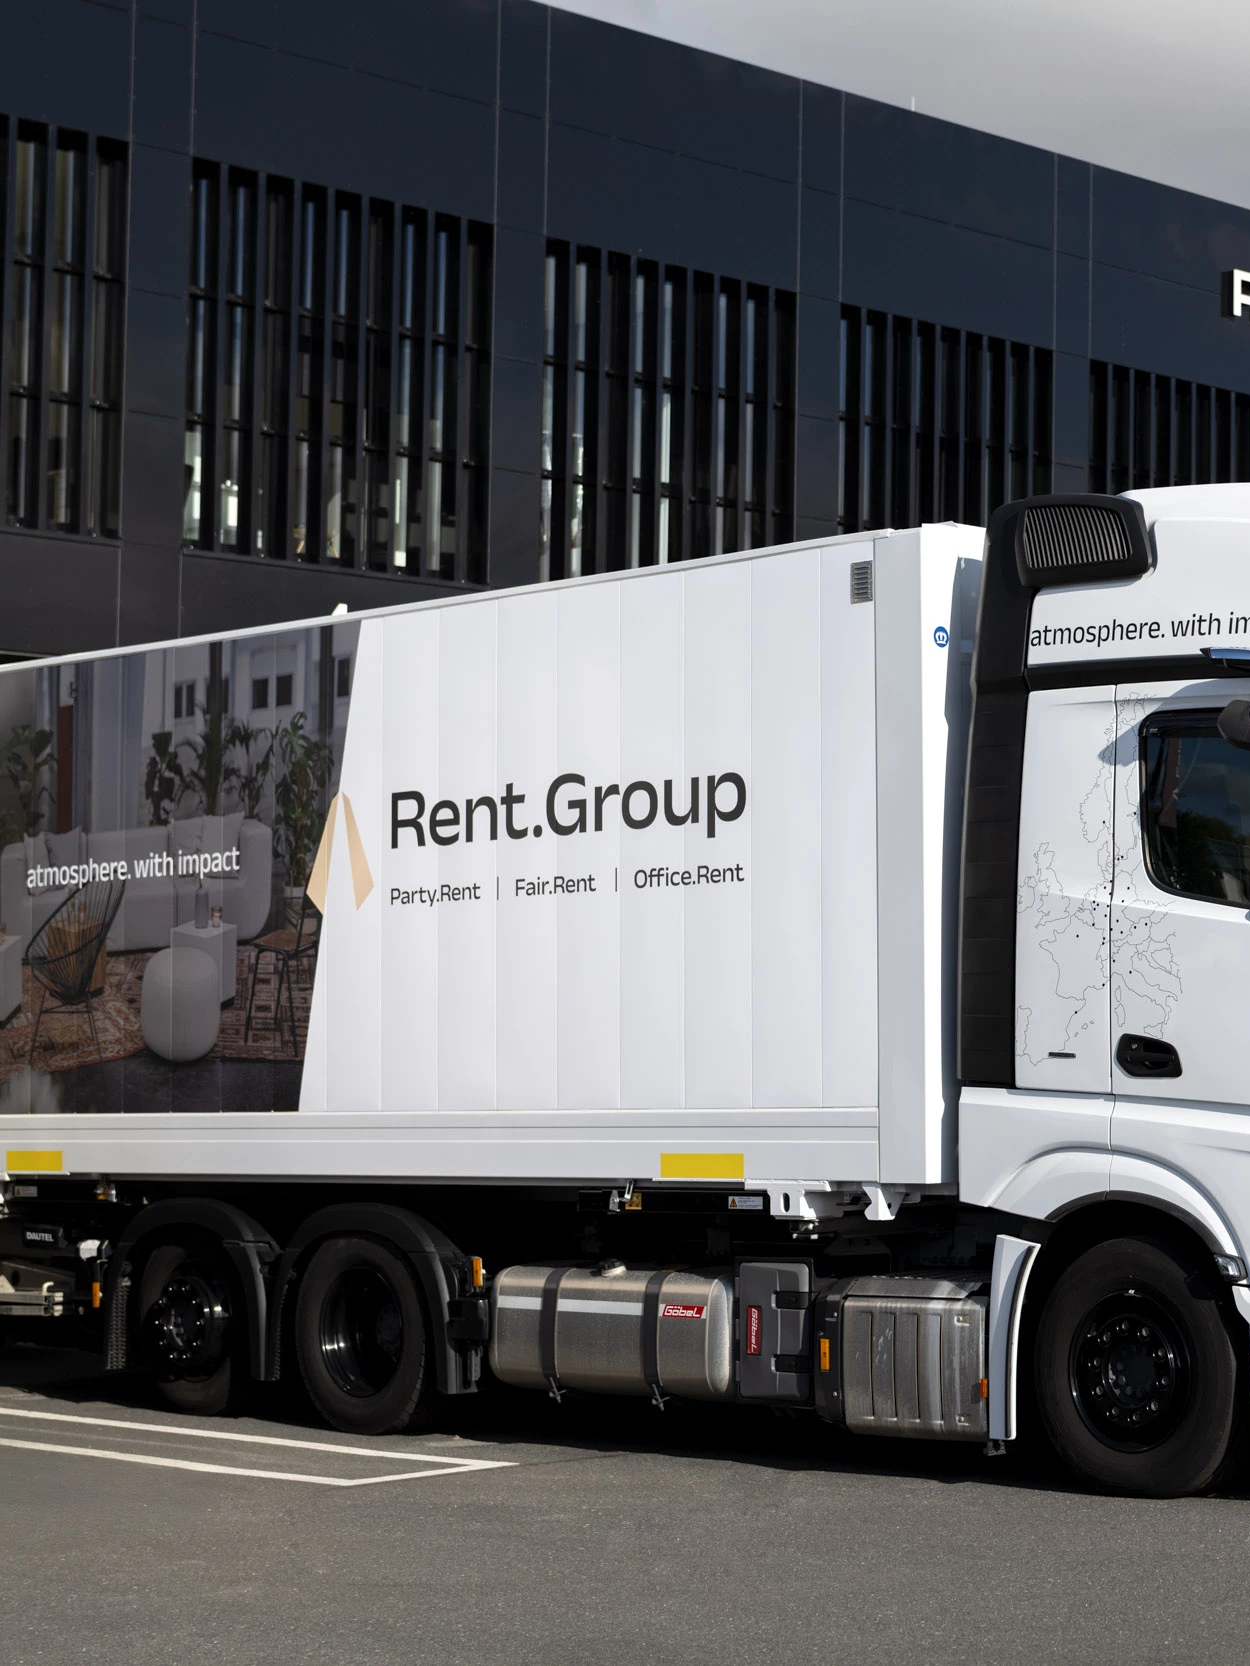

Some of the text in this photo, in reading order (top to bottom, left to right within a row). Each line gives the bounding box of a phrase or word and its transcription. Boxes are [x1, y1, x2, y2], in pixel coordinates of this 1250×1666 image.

[1030, 618, 1165, 648] atmosphere.
[1171, 612, 1221, 638] with
[391, 772, 747, 849] Rent.Group
[27, 846, 240, 889] atmosphere. with impact
[390, 863, 745, 907] Party.Rent Fair.Rent Office.Rent
[26, 1231, 54, 1242] DAUTEL
